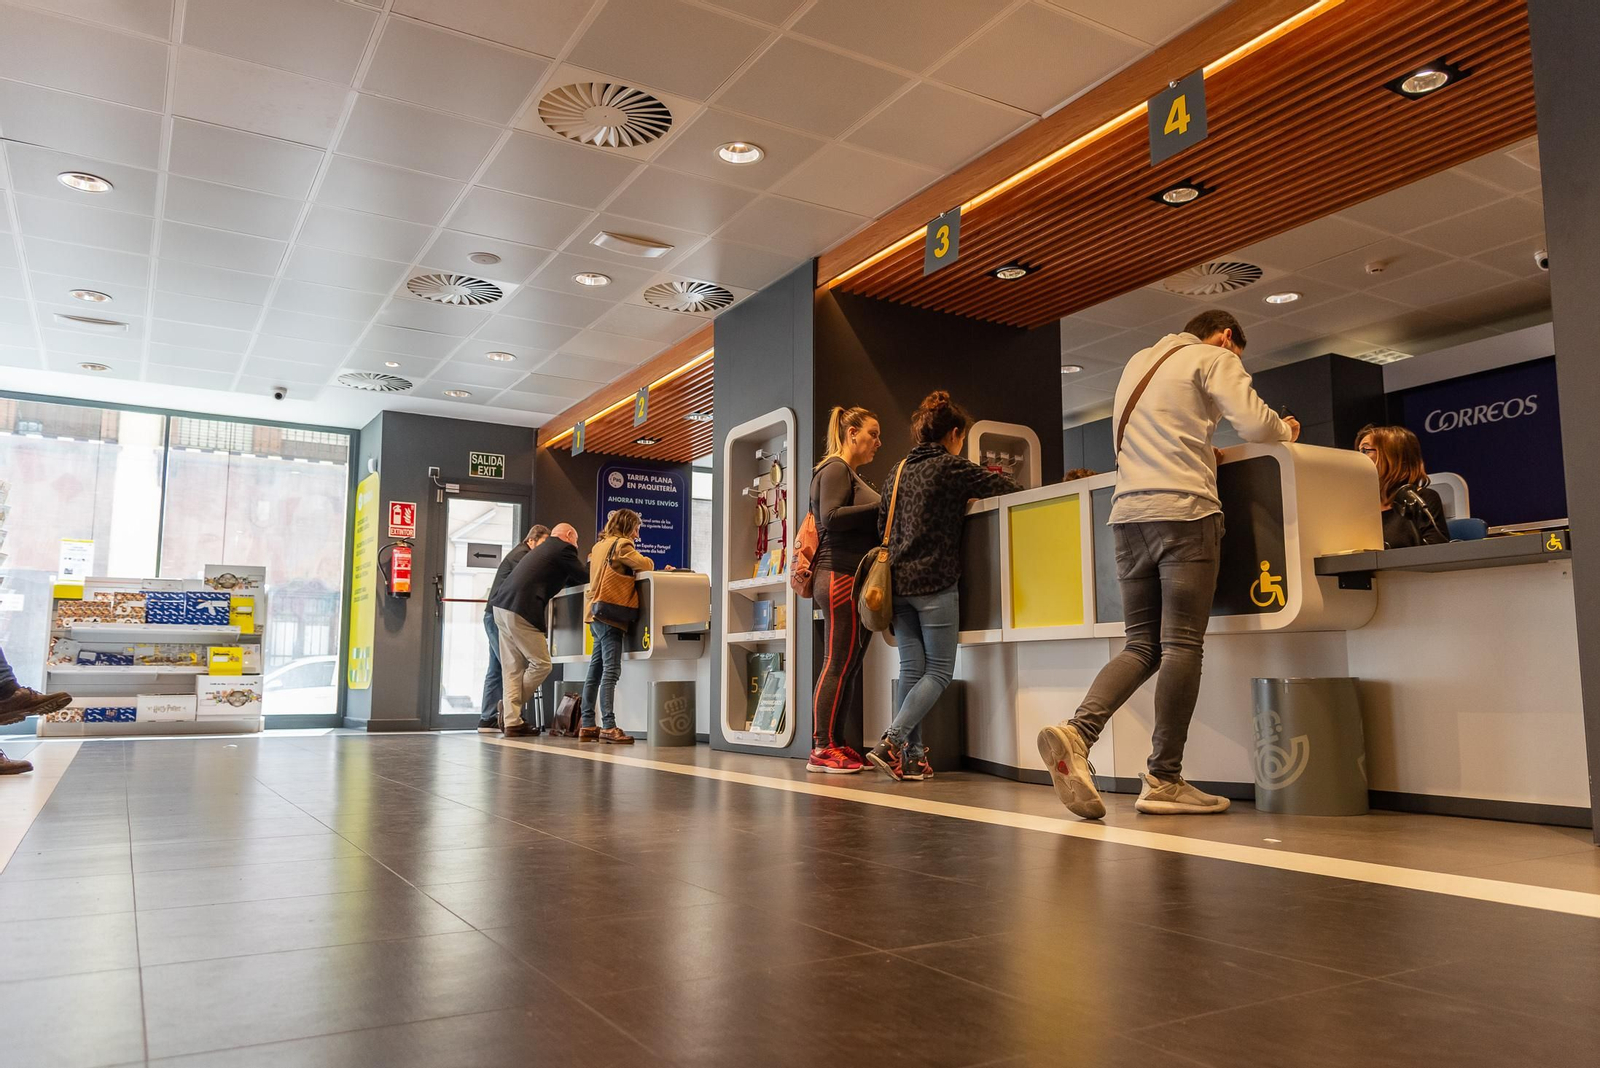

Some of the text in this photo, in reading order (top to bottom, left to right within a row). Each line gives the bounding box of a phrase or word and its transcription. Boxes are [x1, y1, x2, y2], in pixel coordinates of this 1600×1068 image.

[1163, 94, 1190, 135] 4
[934, 224, 950, 258] 3
[638, 396, 644, 418] 2
[1424, 394, 1538, 433] CORREOS
[577, 431, 580, 448] 1
[471, 454, 503, 466] SALIDA
[477, 465, 497, 477] EXIT
[627, 473, 673, 484] TARIFA PLANA
[638, 483, 677, 492] PAQUETERÍA
[608, 496, 634, 504] AHORRA
[390, 527, 414, 536] EXTINTOR
[751, 677, 758, 693] 5
